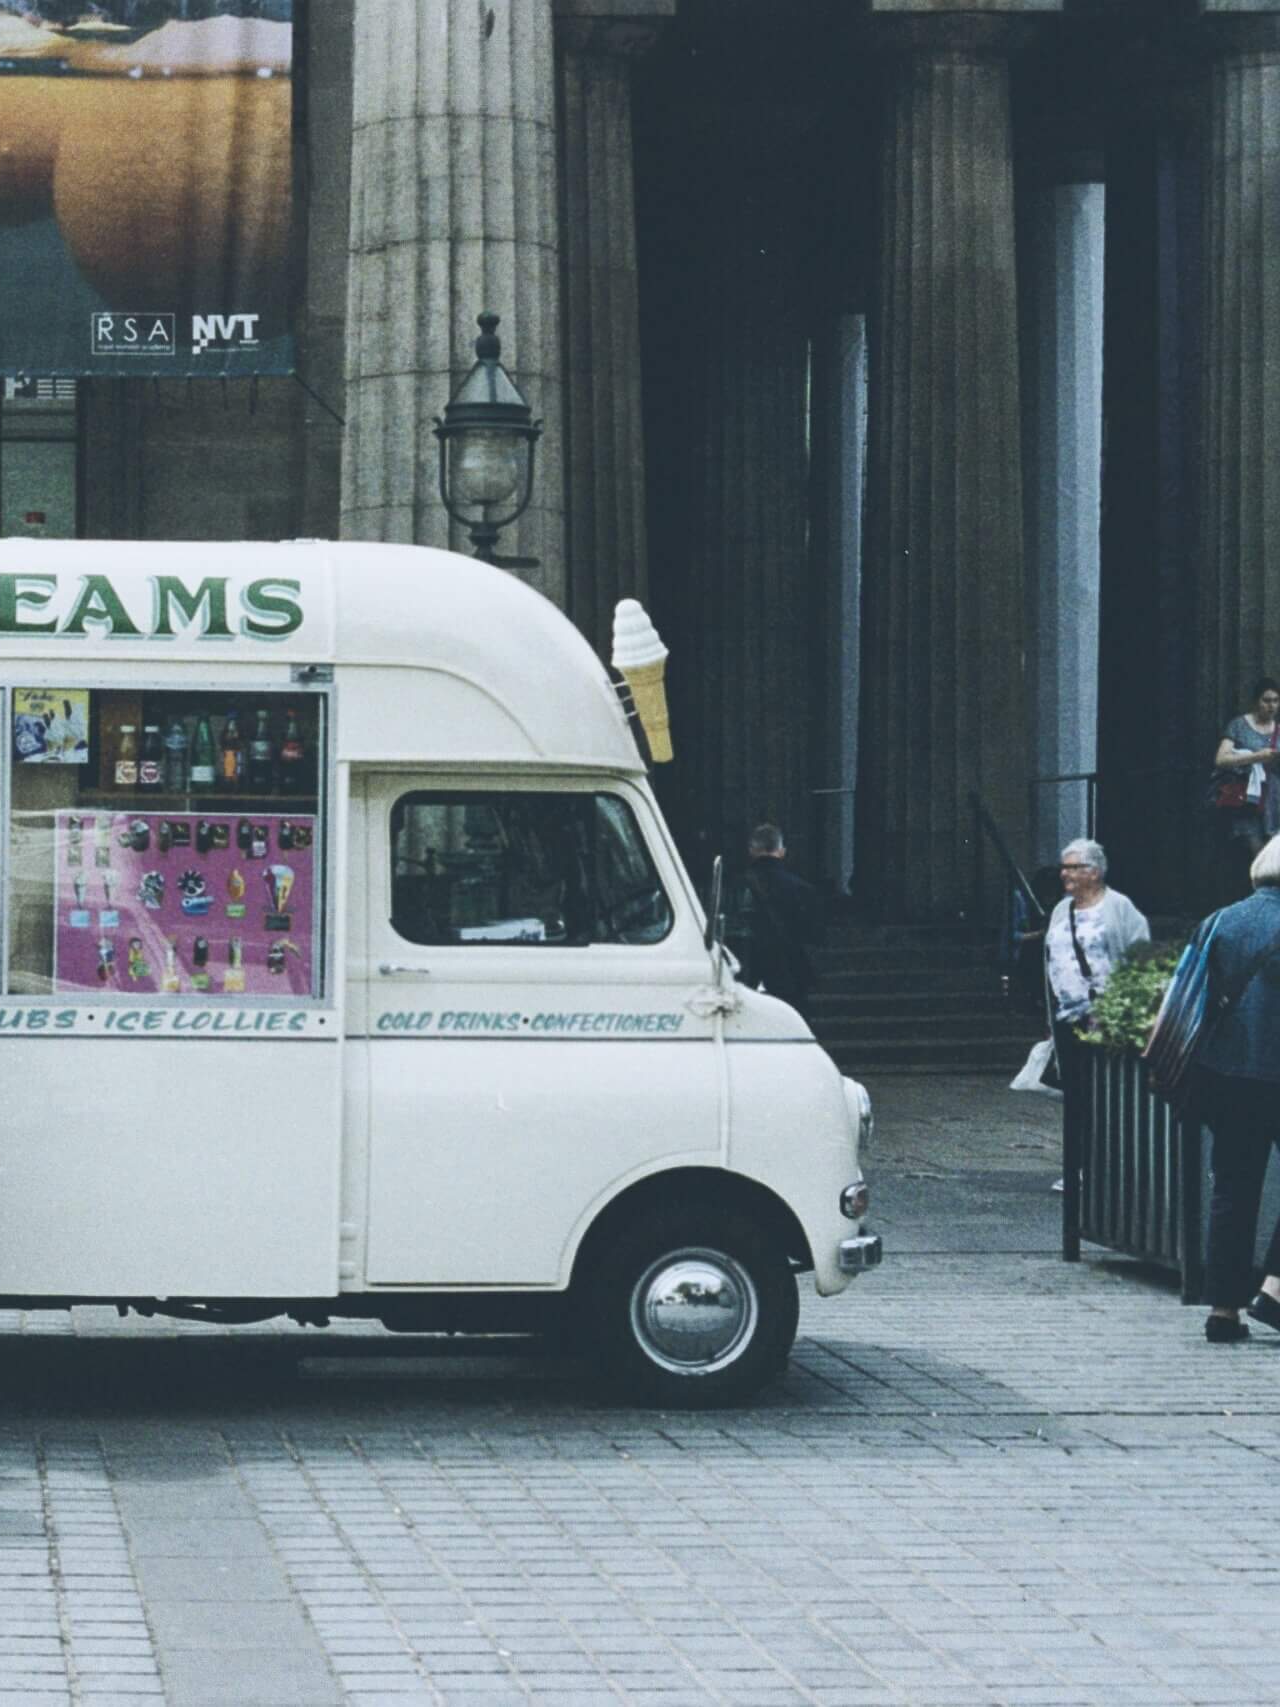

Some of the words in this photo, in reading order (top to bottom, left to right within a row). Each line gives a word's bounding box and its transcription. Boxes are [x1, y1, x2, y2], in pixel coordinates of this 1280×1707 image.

[192, 313, 259, 340] NVT
[377, 1011, 432, 1031] COLD
[437, 1012, 521, 1031] DRINKS
[531, 1014, 685, 1033] CONFECTIONERY
